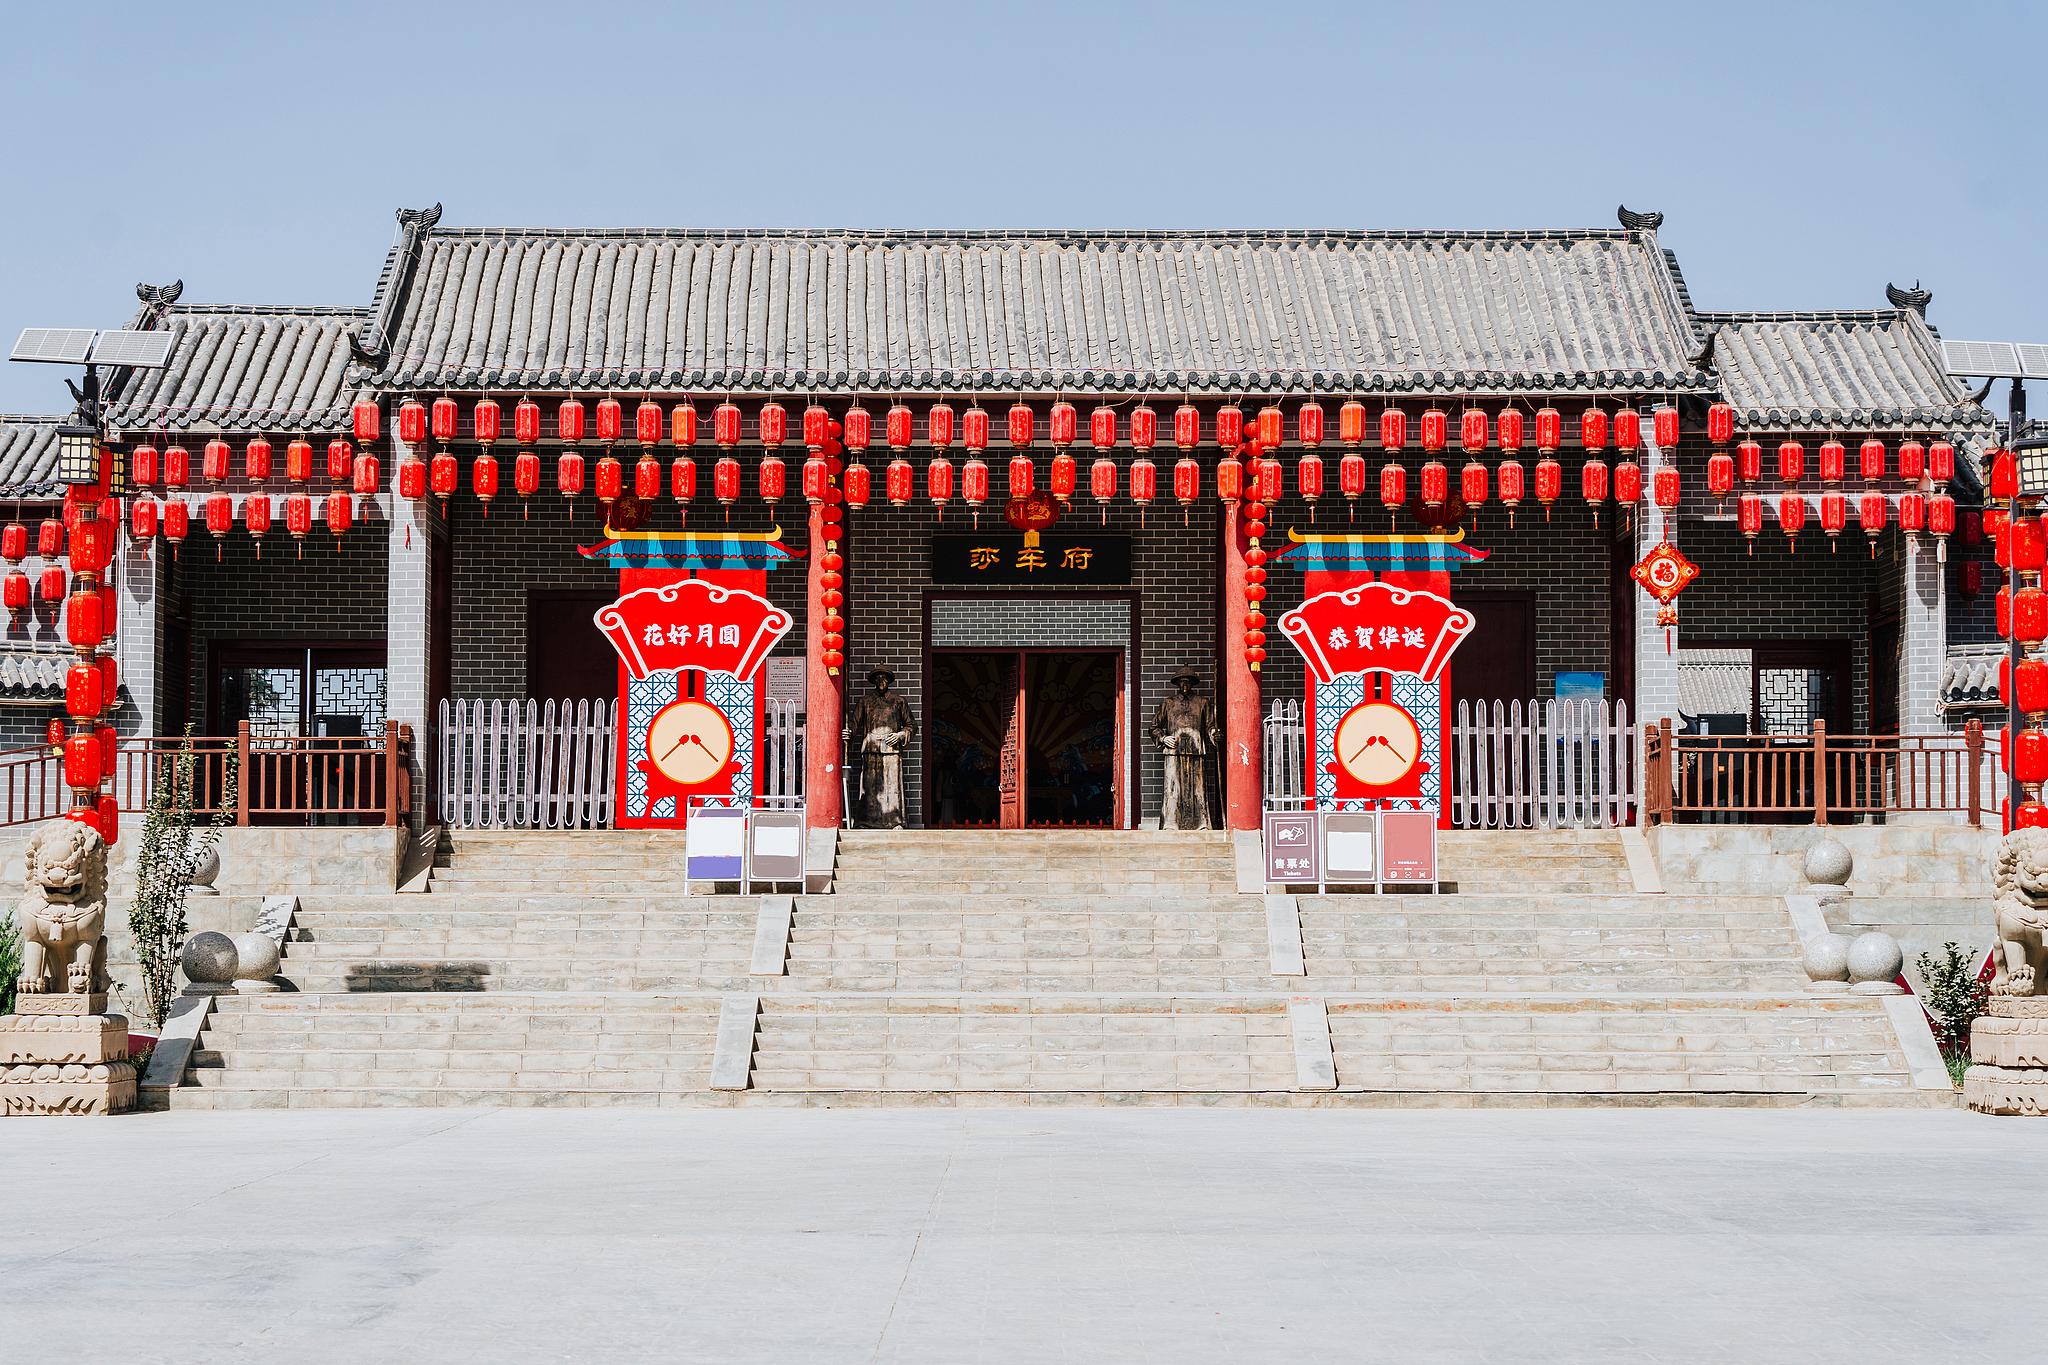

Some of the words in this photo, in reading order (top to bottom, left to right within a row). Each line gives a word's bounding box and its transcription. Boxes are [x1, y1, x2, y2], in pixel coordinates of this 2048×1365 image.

[969, 546, 1093, 572] 莎车府
[1654, 561, 1675, 582] 福
[1327, 625, 1427, 650] 恭贺华诞
[1274, 857, 1310, 869] 售票处
